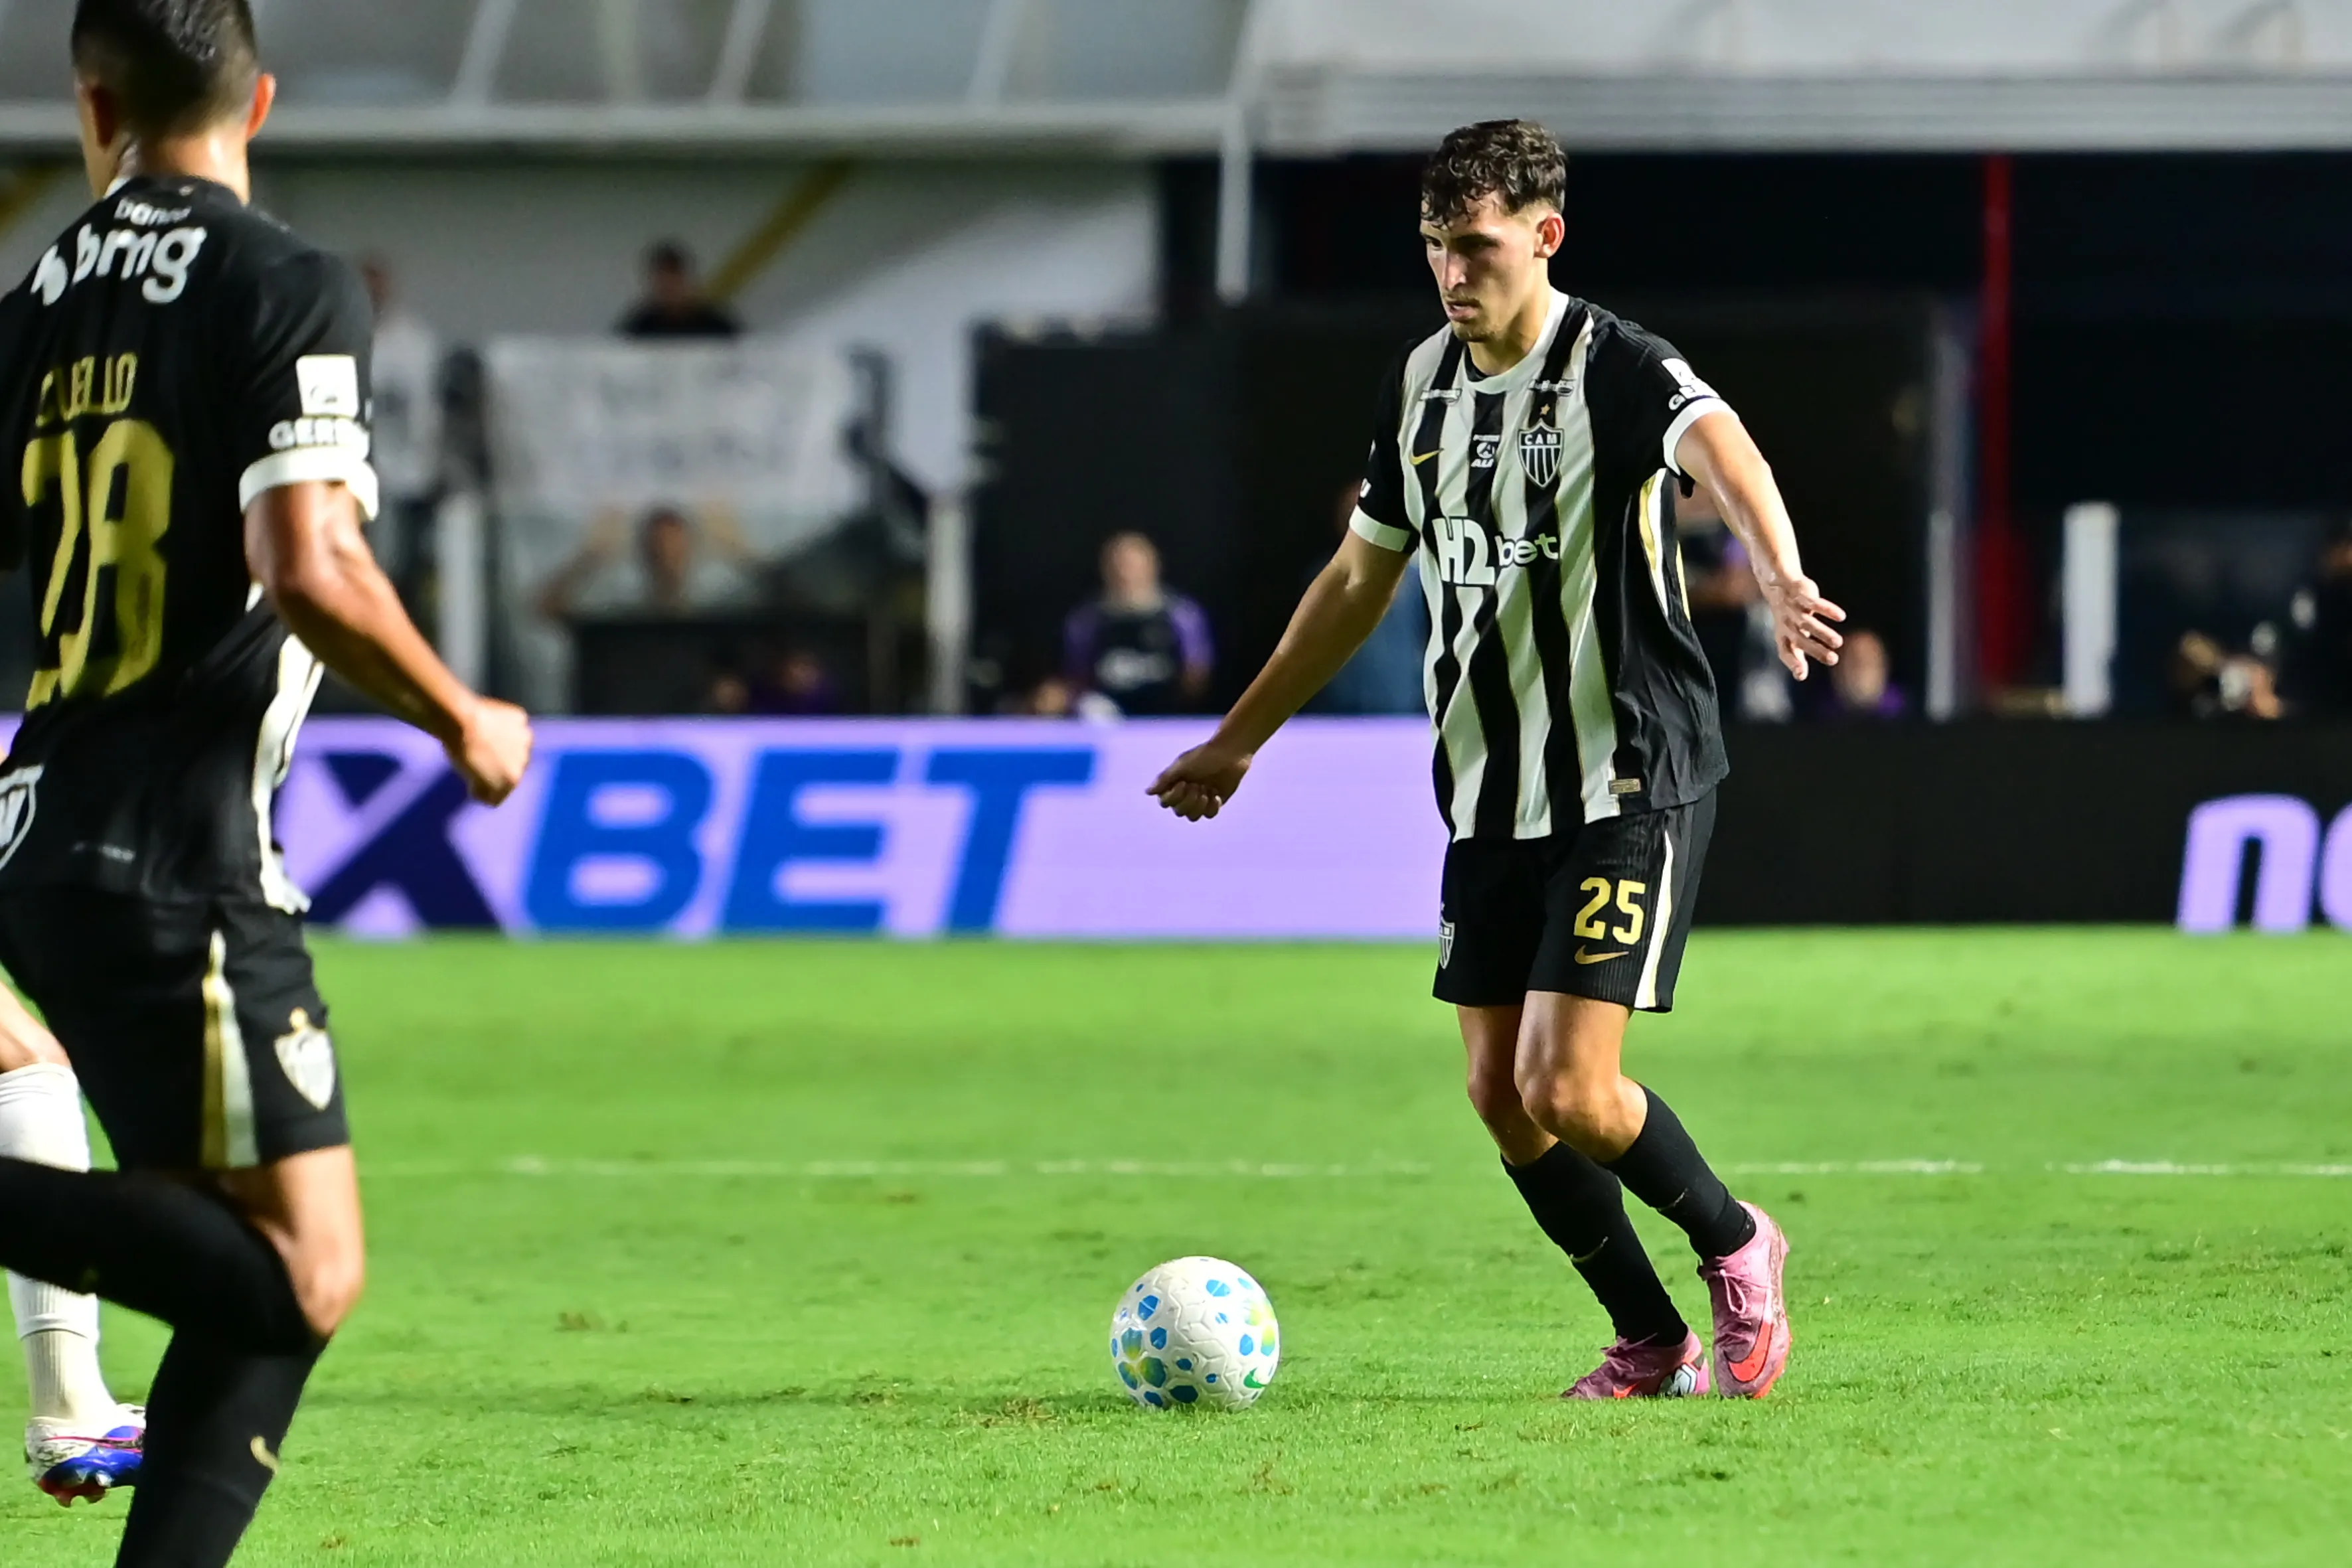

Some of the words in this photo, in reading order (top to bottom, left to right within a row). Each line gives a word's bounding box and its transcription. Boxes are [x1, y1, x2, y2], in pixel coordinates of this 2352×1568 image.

[73, 222, 208, 304] bmg
[1524, 433, 1558, 445] CAM
[271, 750, 1098, 933] XBET
[1573, 877, 1646, 945] 25
